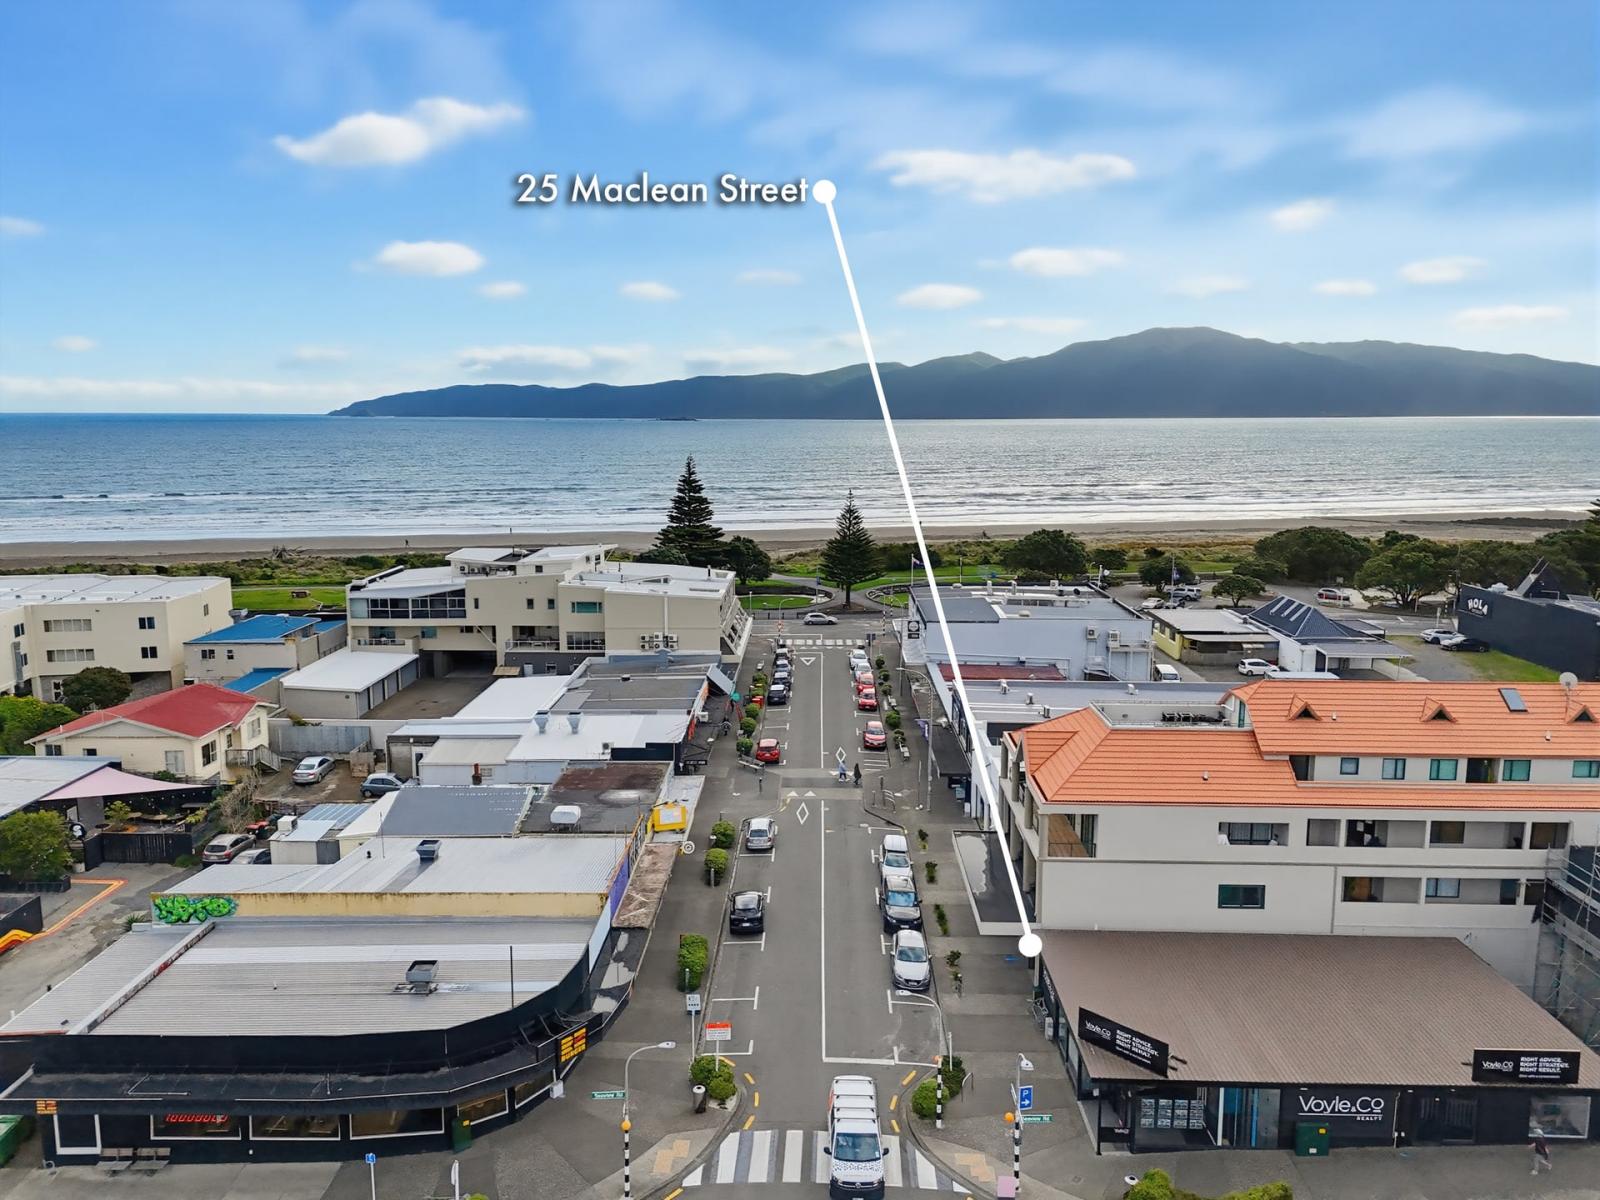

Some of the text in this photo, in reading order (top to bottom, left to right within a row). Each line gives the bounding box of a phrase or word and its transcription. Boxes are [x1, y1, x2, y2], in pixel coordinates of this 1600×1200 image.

[1115, 1029, 1132, 1040] RIGHT
[1115, 1034, 1132, 1045] RIGHT
[1115, 1039, 1131, 1050] RIGHT
[1022, 1089, 1029, 1099] P
